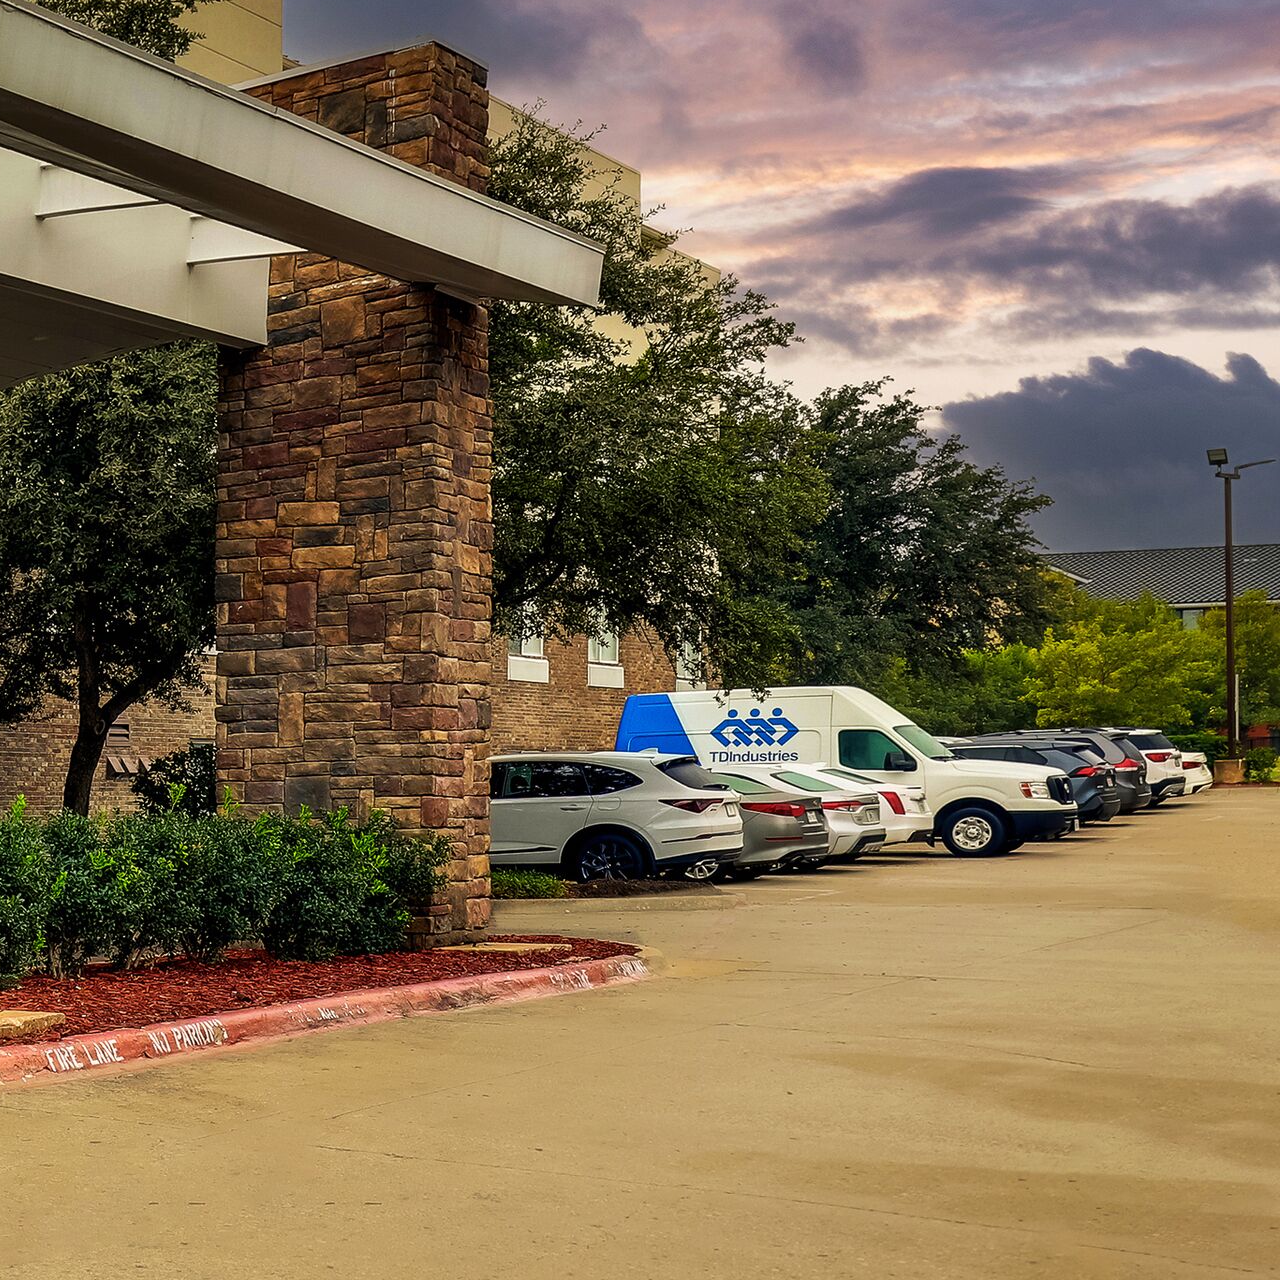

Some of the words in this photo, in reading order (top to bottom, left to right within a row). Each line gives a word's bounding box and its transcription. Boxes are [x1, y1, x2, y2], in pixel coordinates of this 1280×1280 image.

[709, 750, 799, 763] TDIndustries
[44, 1045, 84, 1072] FIRE
[82, 1039, 125, 1066] LANE
